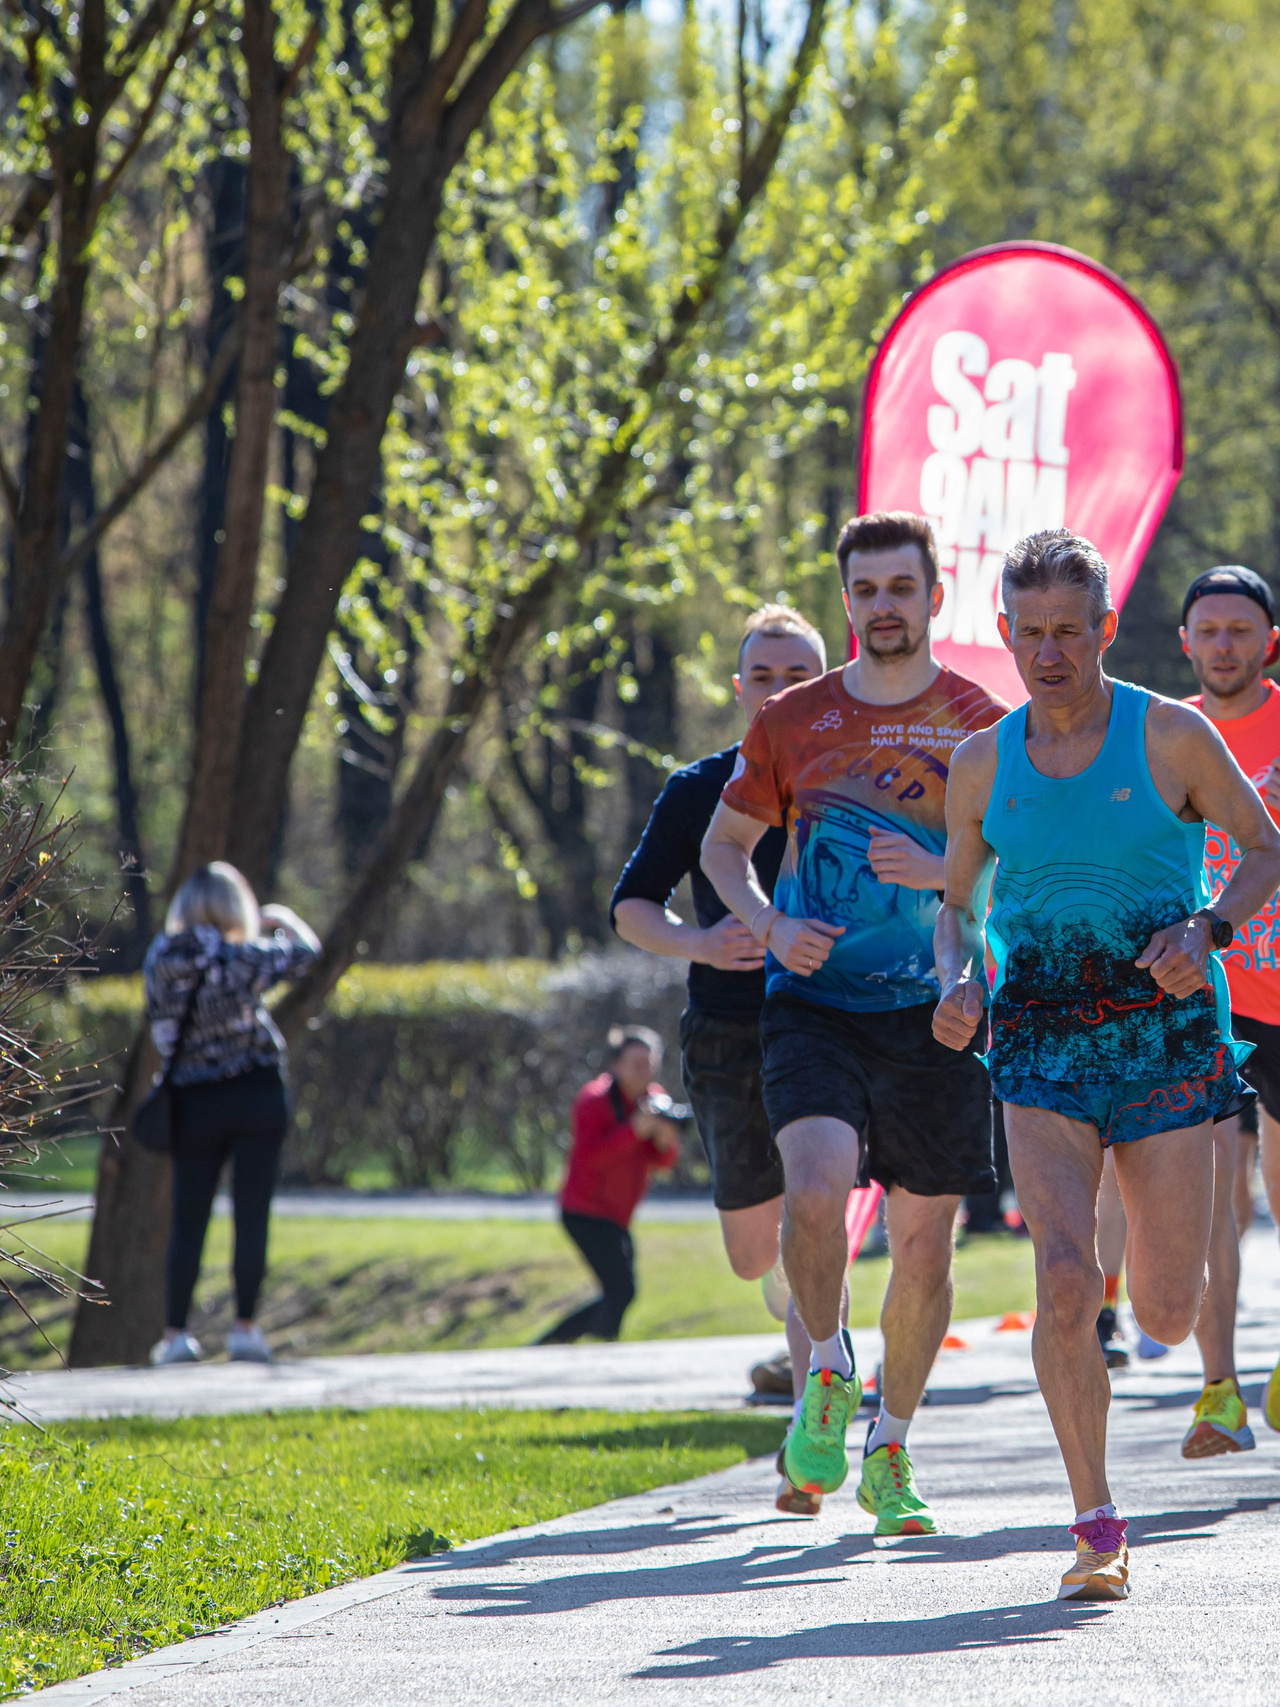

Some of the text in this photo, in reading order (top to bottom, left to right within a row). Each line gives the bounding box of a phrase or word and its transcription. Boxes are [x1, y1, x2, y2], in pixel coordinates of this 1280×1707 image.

[927, 330, 1077, 463] Sat
[919, 451, 1067, 549] 9AM
[930, 547, 1007, 649] 5K
[870, 736, 958, 749] HALF MARATH
[871, 724, 904, 735] LOVE
[907, 725, 934, 736] AND
